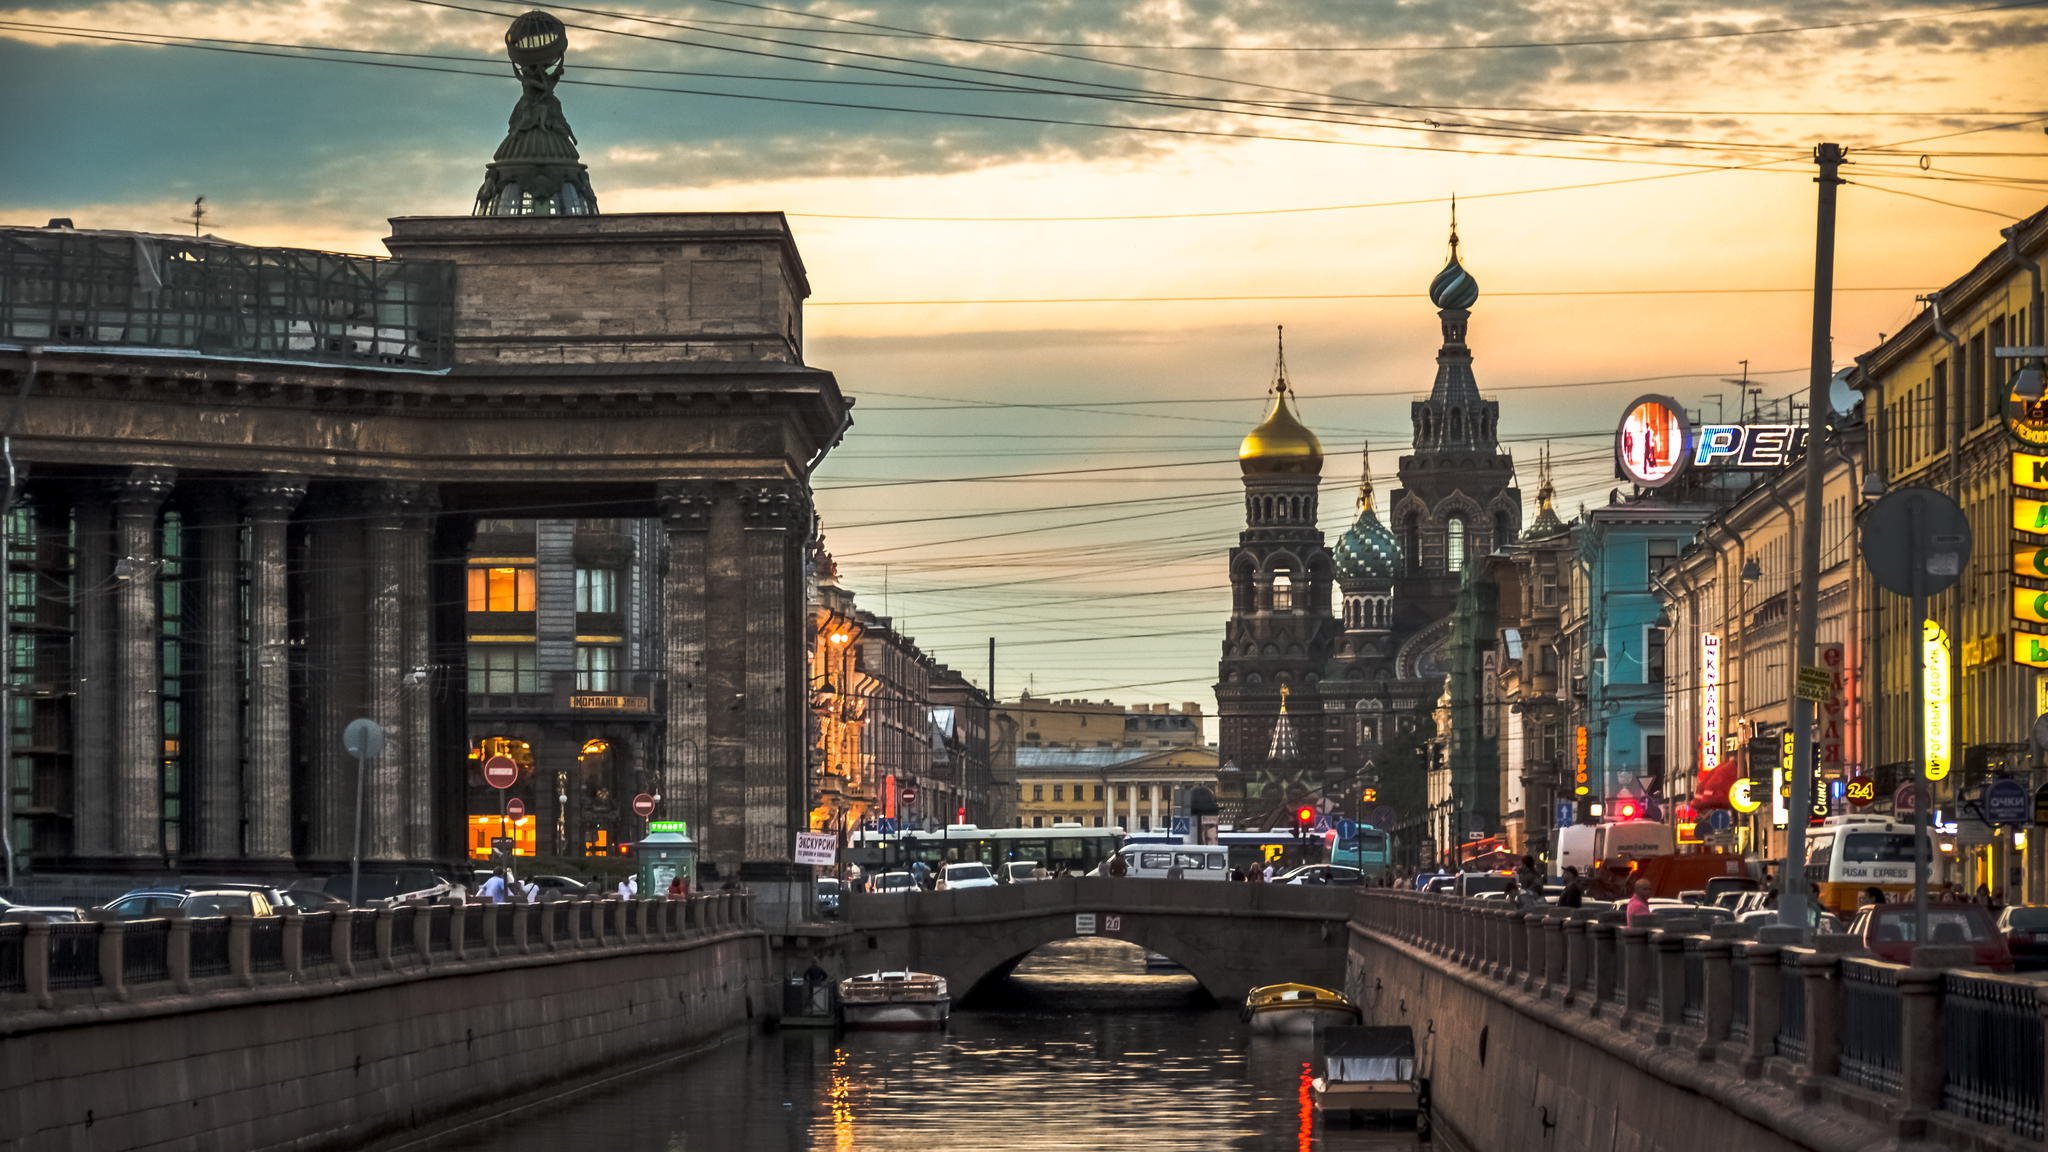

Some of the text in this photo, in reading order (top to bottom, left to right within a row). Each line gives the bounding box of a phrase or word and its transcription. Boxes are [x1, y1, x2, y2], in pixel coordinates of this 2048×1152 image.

[1847, 782, 1874, 800] 24
[1990, 796, 2025, 807] ОЧКИ
[799, 836, 835, 851] ЭКСКУРСИИ
[1842, 867, 1908, 879] PUSAN EXPRESS
